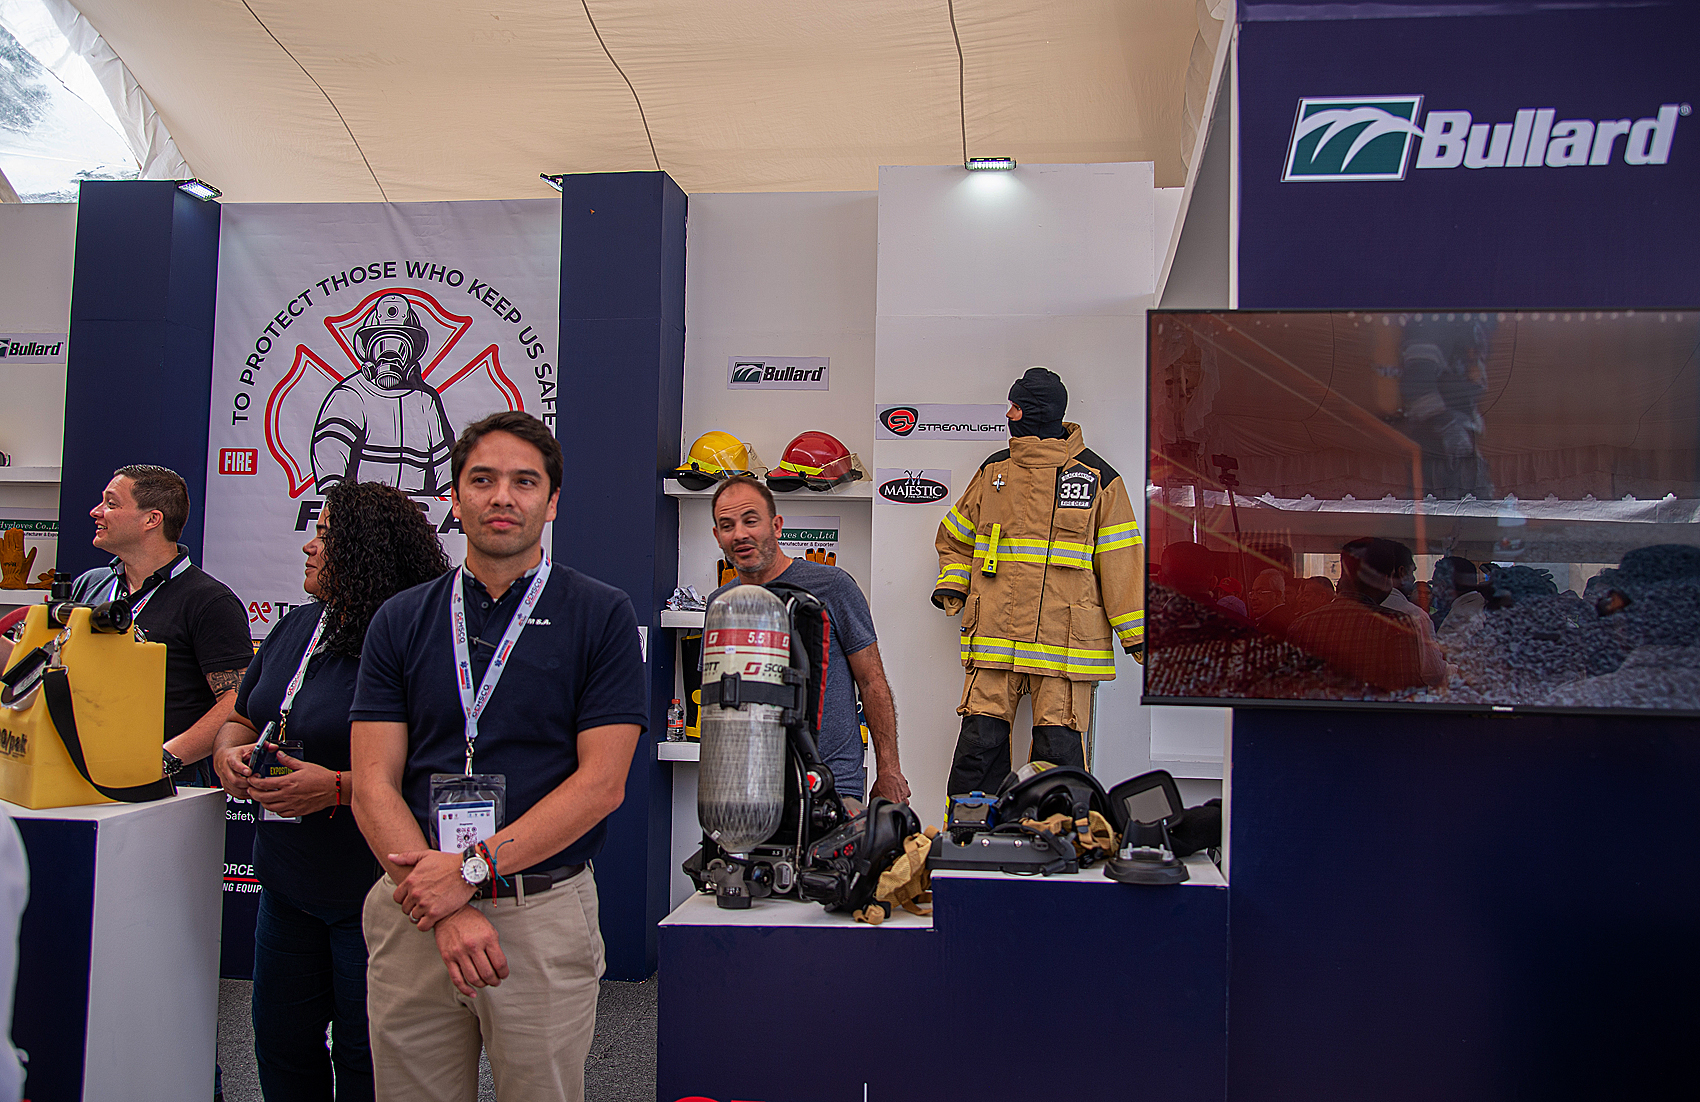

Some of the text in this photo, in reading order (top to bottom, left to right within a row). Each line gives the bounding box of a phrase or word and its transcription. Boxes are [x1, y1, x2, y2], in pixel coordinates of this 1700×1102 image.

[1416, 104, 1679, 169] Bullard
[9, 341, 61, 356] Bullard
[232, 260, 557, 426] TO PROTECT THOSE WHO KEEP US SAFE
[763, 366, 824, 382] Bullard
[224, 451, 252, 472] FIRE
[884, 484, 943, 499] MAJESTIC
[1060, 483, 1091, 500] 331
[747, 631, 765, 644] 5.5
[225, 809, 255, 824] Safety
[223, 863, 255, 876] ORCE
